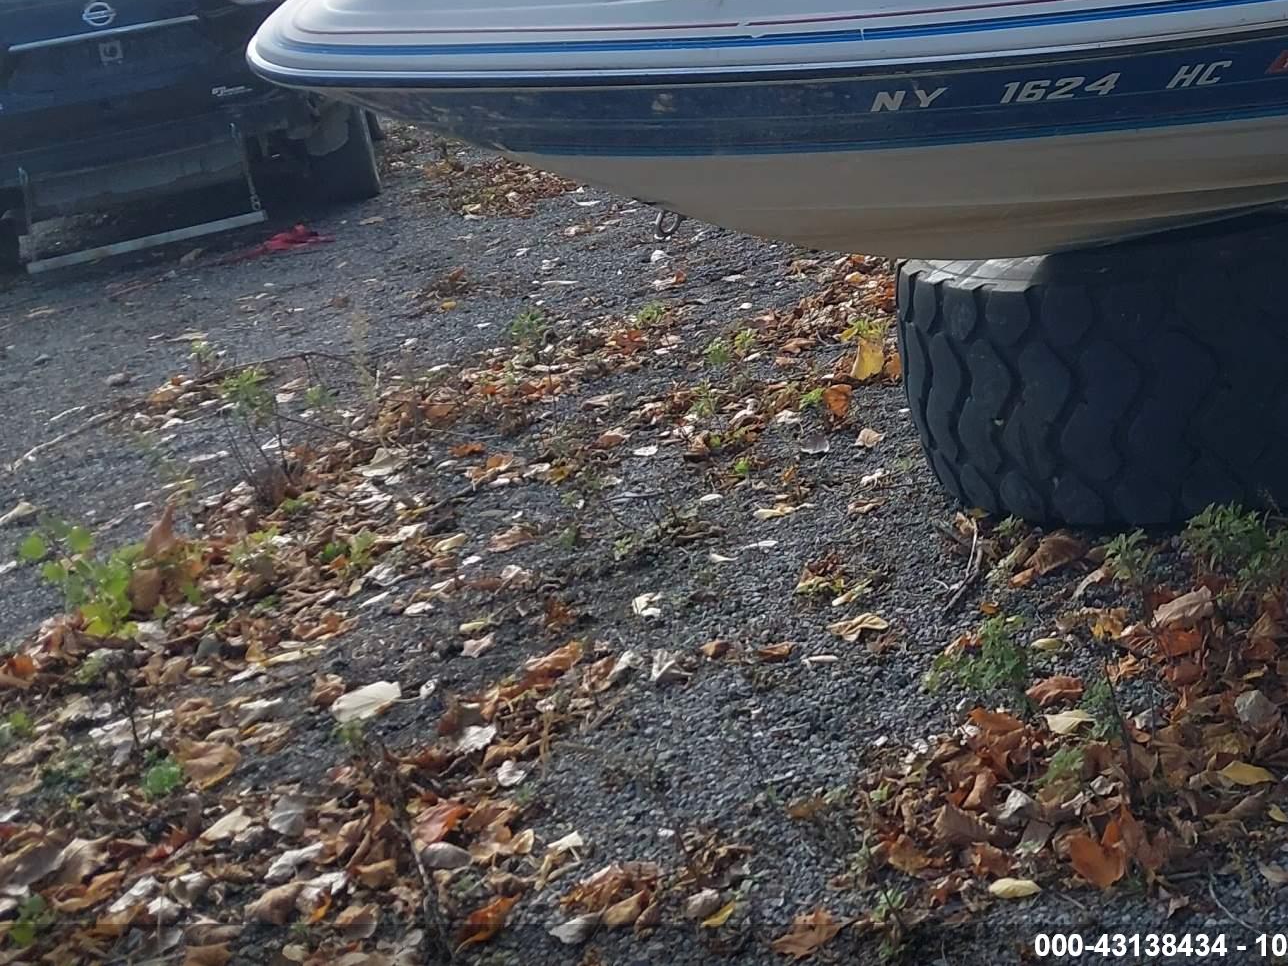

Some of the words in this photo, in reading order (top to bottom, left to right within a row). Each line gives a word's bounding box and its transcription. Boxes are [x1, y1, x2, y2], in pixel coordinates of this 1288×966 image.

[871, 87, 947, 112] NY
[1000, 73, 1121, 104] 1624
[1166, 60, 1232, 89] HC
